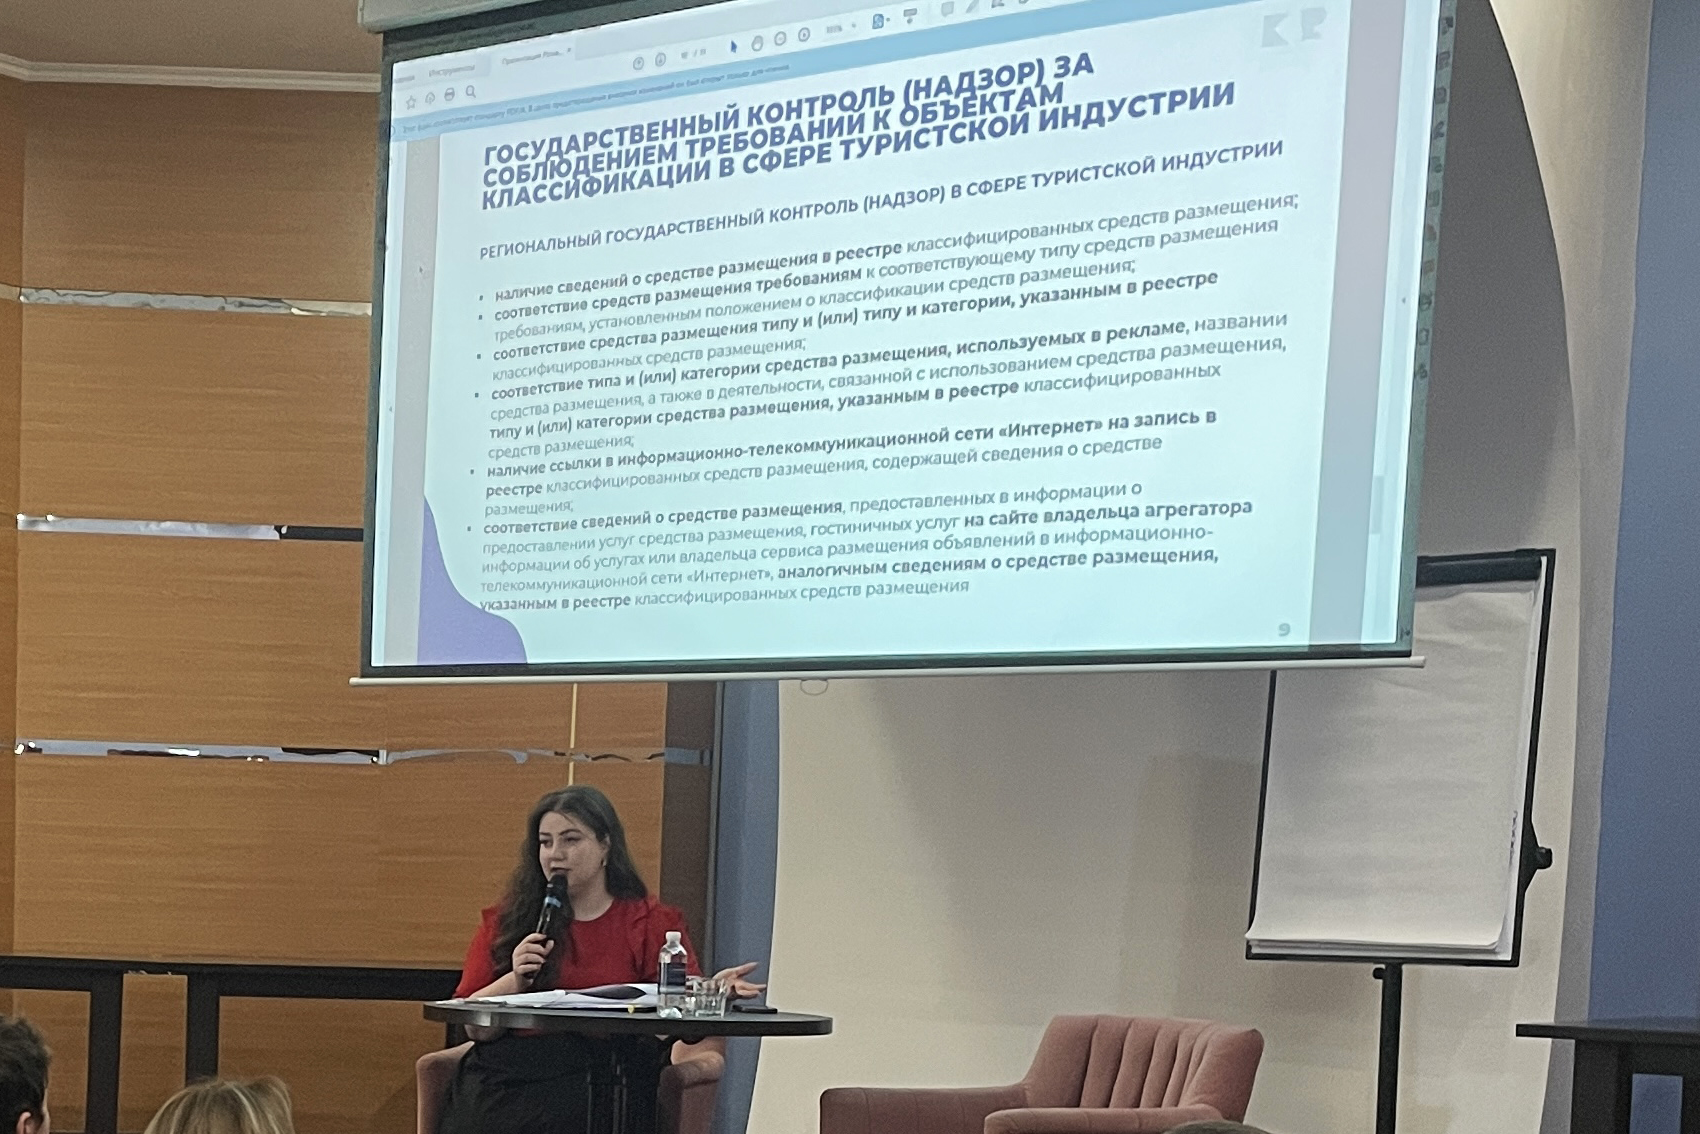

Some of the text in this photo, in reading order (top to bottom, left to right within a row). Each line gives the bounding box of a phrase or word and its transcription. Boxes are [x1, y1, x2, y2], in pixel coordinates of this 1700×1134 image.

[482, 81, 1234, 211] КЛАССИФИКАЦИИ В СФЕРЕ ТУРИСТСКОЙ ИНДУСТРИИ
[483, 81, 1064, 190] СОБЛЮДЕНИЕМ ТРЕБОВАНИЙ К ОБЪЕКТАМ
[484, 102, 740, 168] ГОСУДАРСТВЕННЫЙ
[747, 83, 896, 127] КОНТРОЛЬ
[903, 57, 1045, 107] (НАДЗОР)
[1053, 51, 1095, 80] ЗА
[480, 140, 1284, 261] РЕГИОНАЛЬНЫЙ ГОСУДАРСТВЕННЫЙ КОНТРОЛЬ (НАДЗОР) В СФЕРЕ ТУРИСТСКОЙ ИНДУСТРИИ
[494, 219, 1278, 322] соответствие средств размещения требованиям соответствующему типу средств размещения
[495, 194, 1298, 303] наличие сведений о средстве размещения реестре классифицированных средств размещения;
[493, 272, 1219, 361] соответствие средства размещения типу и (или) типу и категории, указанным в реестре
[494, 259, 1135, 345] требованиям, установленным положением классификации средств размещения;
[490, 336, 1287, 423] средства размещения, также деятельности, связанной использованием средства размещения,
[491, 311, 1288, 399] соответствие типа (или) категории средства размещения, используемых в рекламе, названии
[492, 338, 806, 381] классифицированных средств размещения;
[489, 363, 1221, 441] типу (или) категории средства размещения, указанным реестре классифицированных
[486, 437, 1163, 502] реестре классифицированных средств размещения, содержащей сведения средстве
[487, 410, 1216, 478] наличие ссылки информационно-телекоммуникационной сети «Интернет» на запись в
[487, 435, 634, 464] средств размещения;
[482, 499, 1253, 559] предоставлении услуг средства размещения, гостиничных услуг на сайте владельца агрегатора
[483, 484, 1143, 536] соответствие сведений средстве размещения, предоставленных информации о
[484, 501, 574, 522] размещения;
[481, 524, 1213, 578] информации об услугах или владельца сервиса размещения объявлений информационно-
[481, 547, 1219, 595] телекоммуникационной сети «Интернет», аналогичным сведениям о средстве размещения,
[480, 580, 970, 617] указанным реестре классифицированных средств размещения
[1278, 622, 1291, 638] 9
